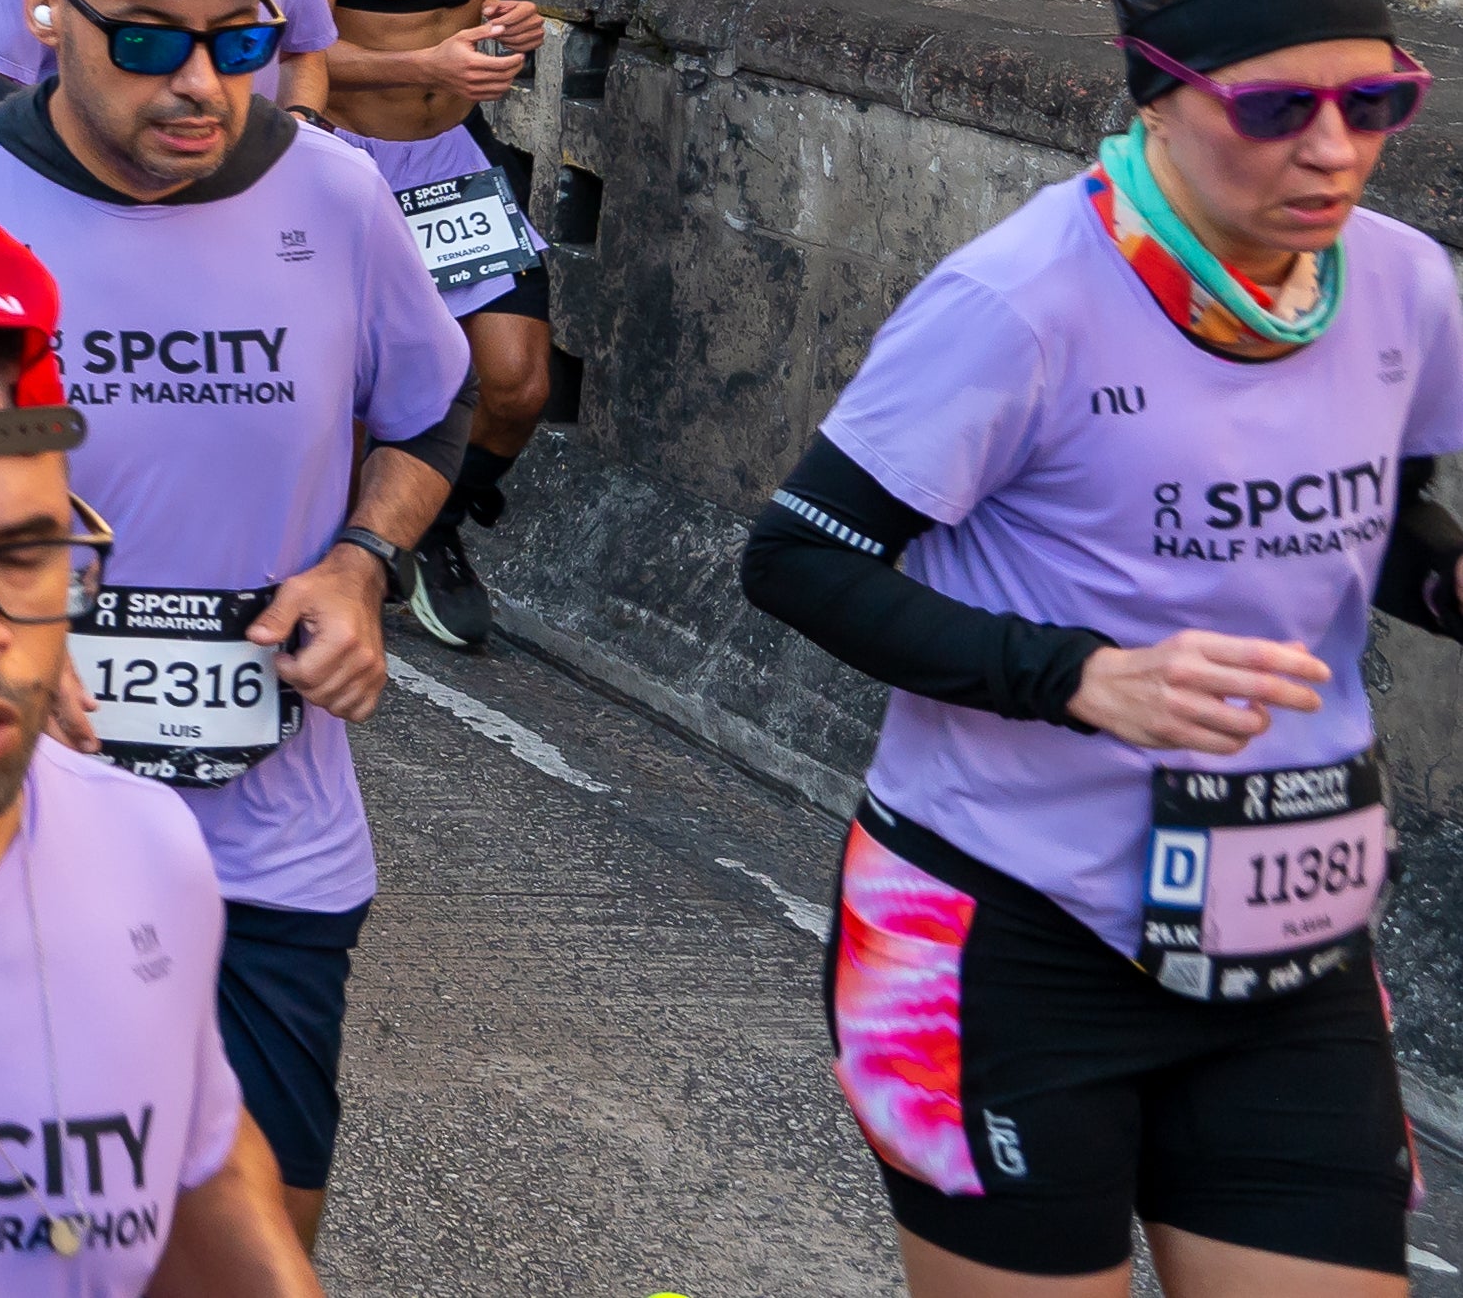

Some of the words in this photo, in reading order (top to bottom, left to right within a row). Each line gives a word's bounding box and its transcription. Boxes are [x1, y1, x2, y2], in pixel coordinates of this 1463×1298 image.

[415, 181, 458, 200] SPCITY
[418, 193, 461, 208] MARATHON
[417, 211, 491, 249] 7013
[437, 244, 491, 262] FERNANDO
[83, 327, 288, 375] SPCITY
[66, 382, 122, 406] ALF
[130, 380, 296, 405] MARATHON
[1204, 456, 1388, 529] SPCITY
[1153, 535, 1246, 562] HALF
[1256, 515, 1388, 558] MARATHON
[127, 593, 222, 615] SPCITY
[127, 615, 222, 631] MARATHON
[94, 659, 264, 708] 12316
[159, 723, 202, 738] LUIS
[1163, 846, 1197, 888] D
[1246, 837, 1367, 906] 11381
